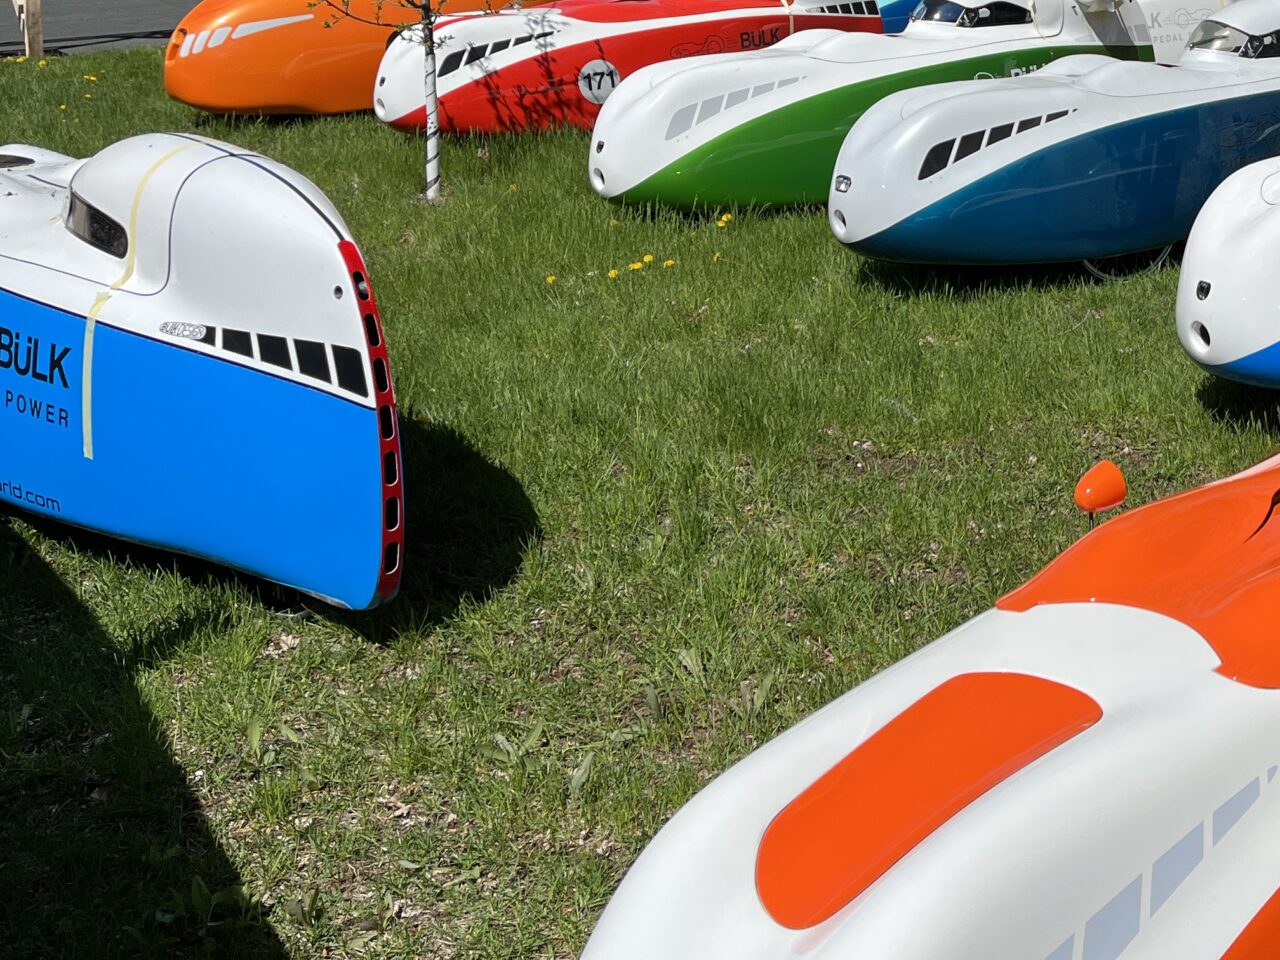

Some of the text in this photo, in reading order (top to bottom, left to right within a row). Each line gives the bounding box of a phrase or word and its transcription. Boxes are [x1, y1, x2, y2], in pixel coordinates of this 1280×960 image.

[1153, 32, 1184, 44] PEDAL
[584, 71, 616, 91] 171
[0, 327, 72, 389] BÜLK
[6, 390, 69, 428] POWER
[0, 480, 60, 512] rld.com
